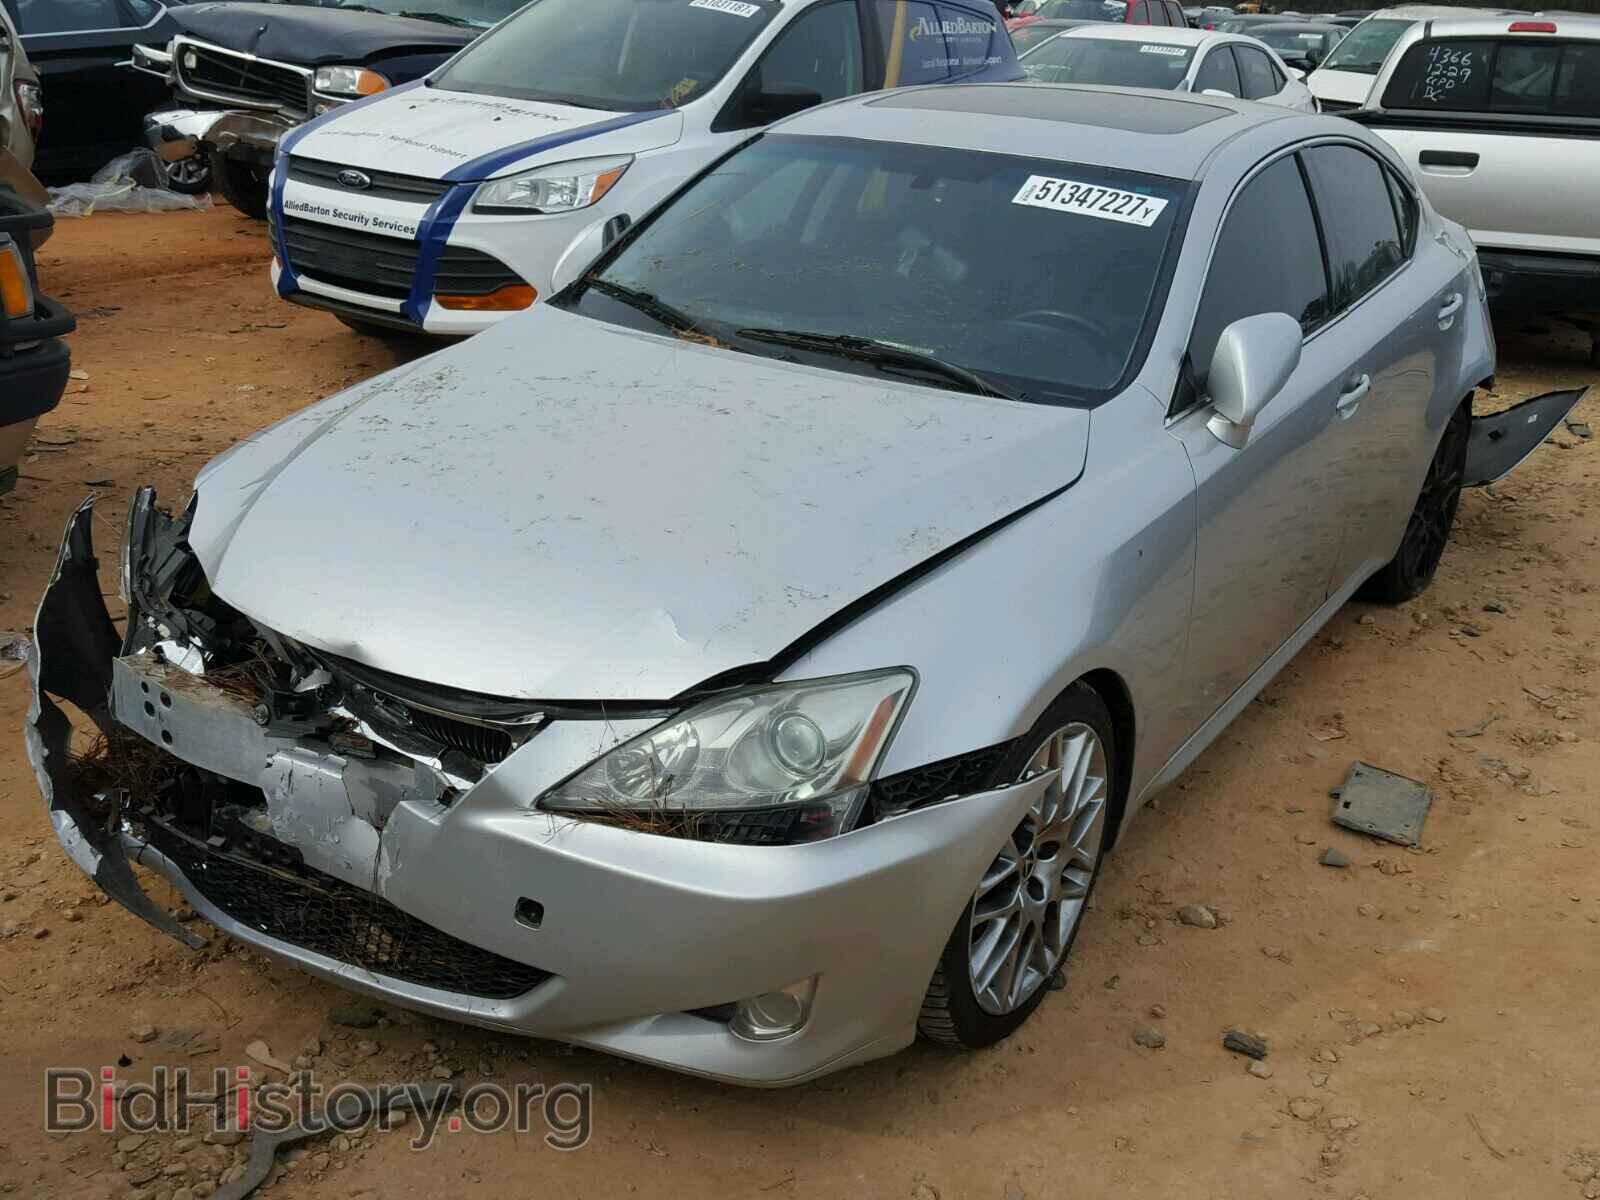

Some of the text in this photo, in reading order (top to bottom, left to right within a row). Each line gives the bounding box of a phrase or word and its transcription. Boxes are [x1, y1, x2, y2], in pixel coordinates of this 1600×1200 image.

[1429, 46, 1472, 66] 4366
[284, 199, 416, 235] AlliedBarton Security Services
